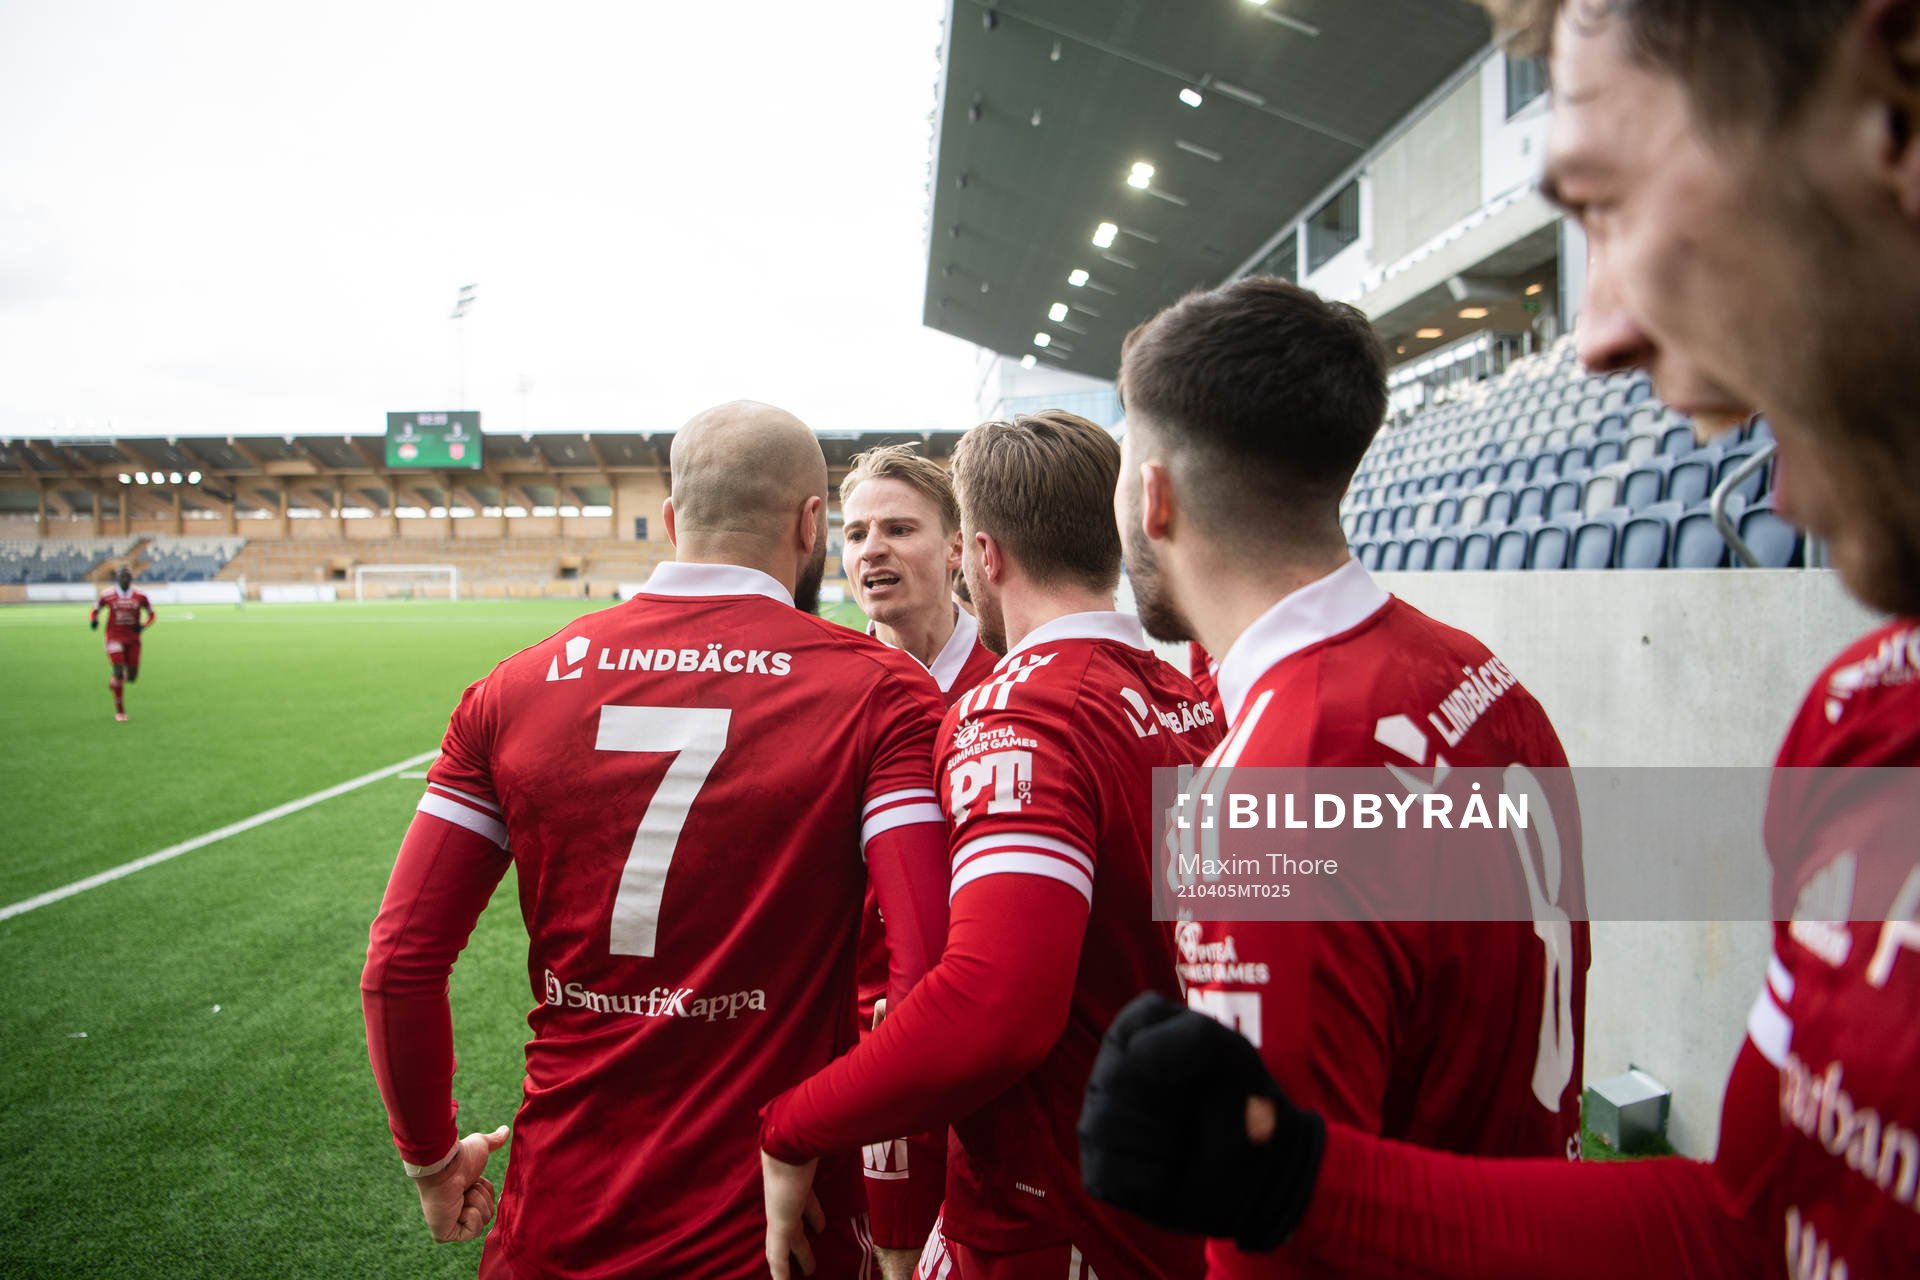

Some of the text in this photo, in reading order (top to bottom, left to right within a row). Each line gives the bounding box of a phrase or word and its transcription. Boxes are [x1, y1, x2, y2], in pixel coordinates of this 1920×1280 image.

[597, 643, 793, 677] LINDBÄCKS
[979, 725, 1016, 742] PITEÅ
[947, 737, 1038, 771] SUMMER GAMES
[950, 750, 1033, 827] PT
[594, 704, 732, 958] 7
